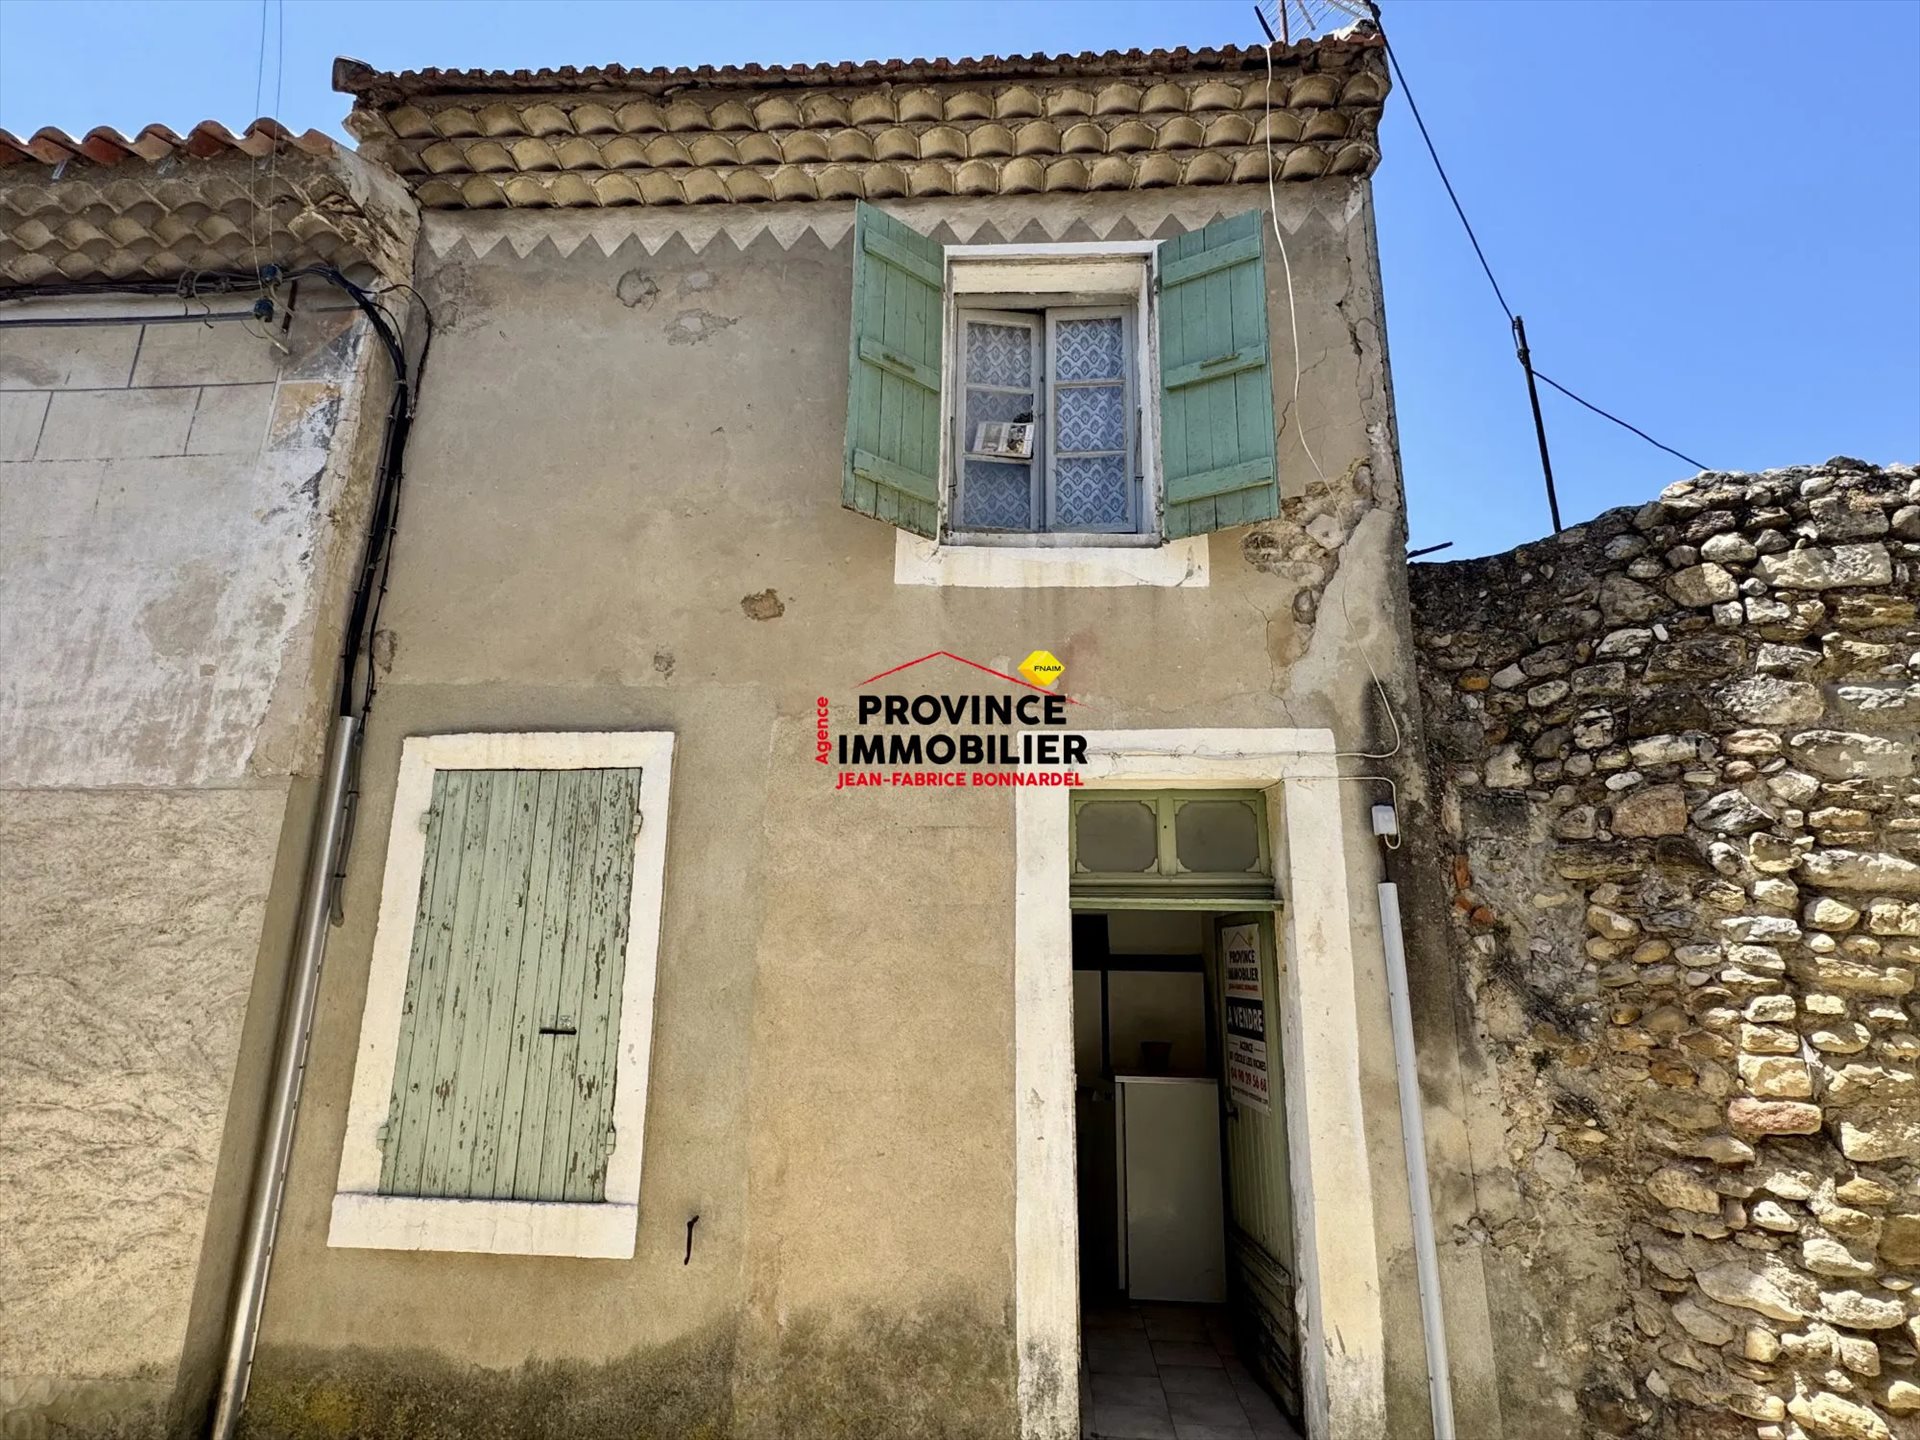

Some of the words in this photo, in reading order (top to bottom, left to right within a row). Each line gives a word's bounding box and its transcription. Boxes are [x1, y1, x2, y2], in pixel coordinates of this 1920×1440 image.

[1229, 949, 1255, 964] PROVINCE
[1228, 967, 1259, 982] IMMOBILIER
[1233, 1006, 1263, 1032] VENDRE
